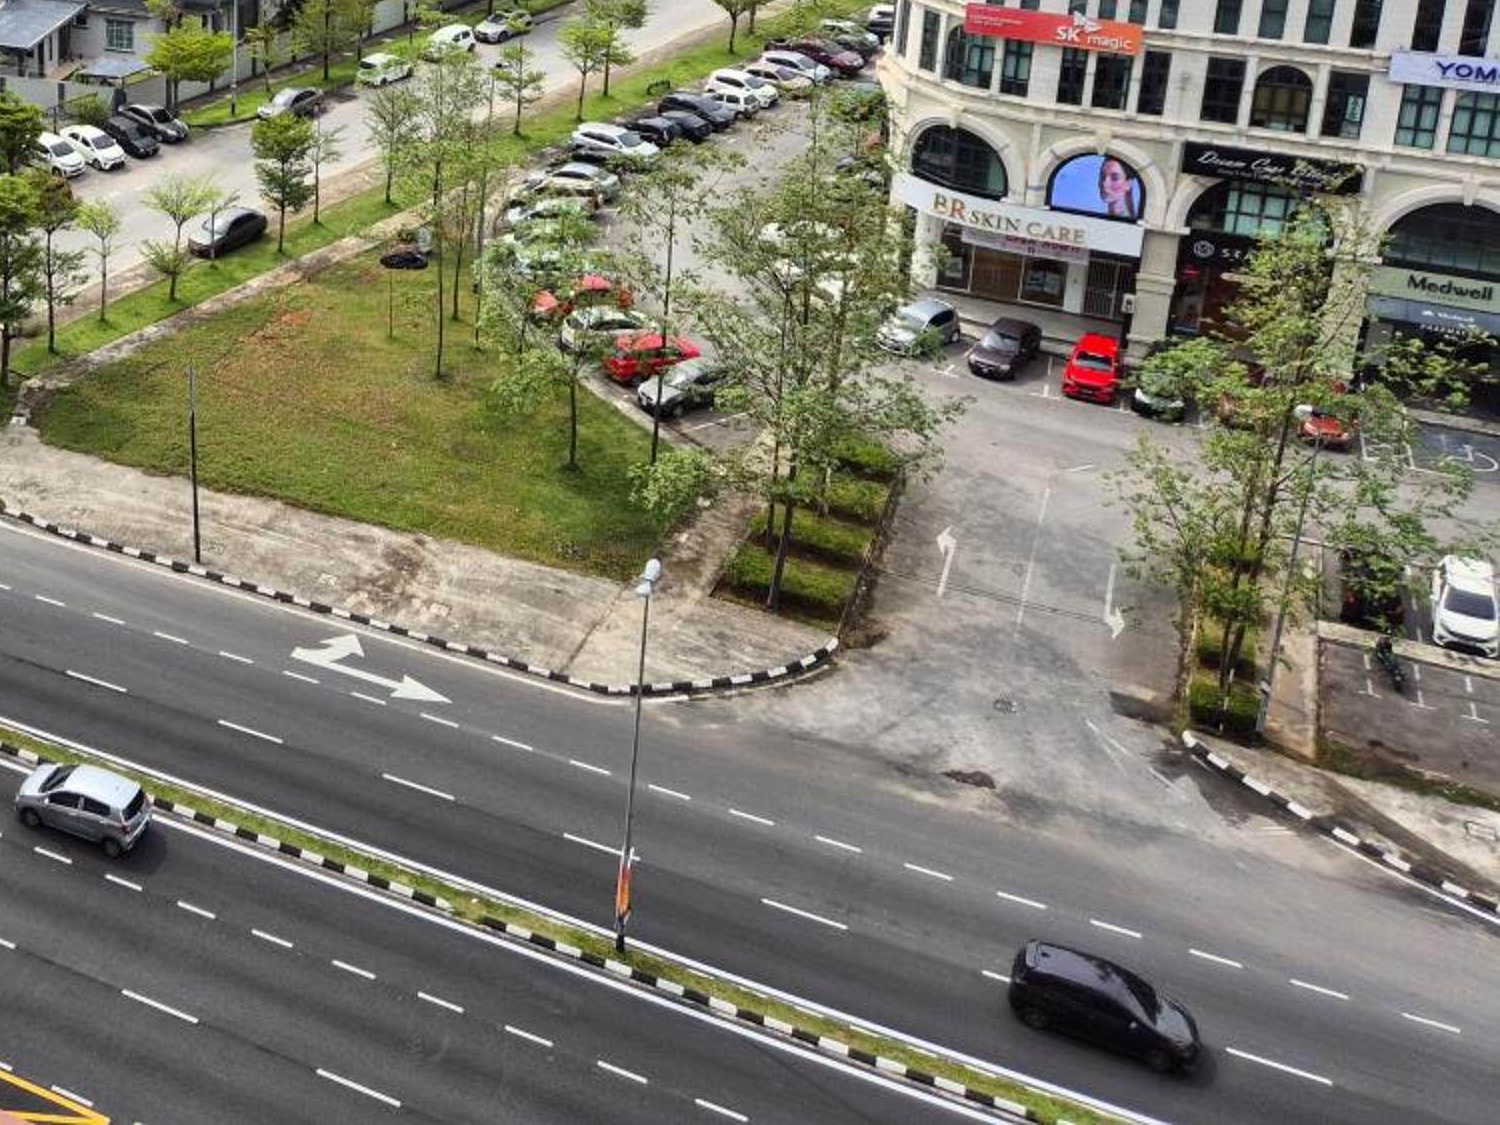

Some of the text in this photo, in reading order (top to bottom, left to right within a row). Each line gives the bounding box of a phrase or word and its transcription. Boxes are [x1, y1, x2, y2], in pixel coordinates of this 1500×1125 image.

[1055, 26, 1133, 51] SK magic
[1435, 61, 1500, 82] YOM
[969, 210, 1021, 232] SKIN
[1026, 222, 1086, 244] CARE
[1407, 275, 1494, 300] Medwell
